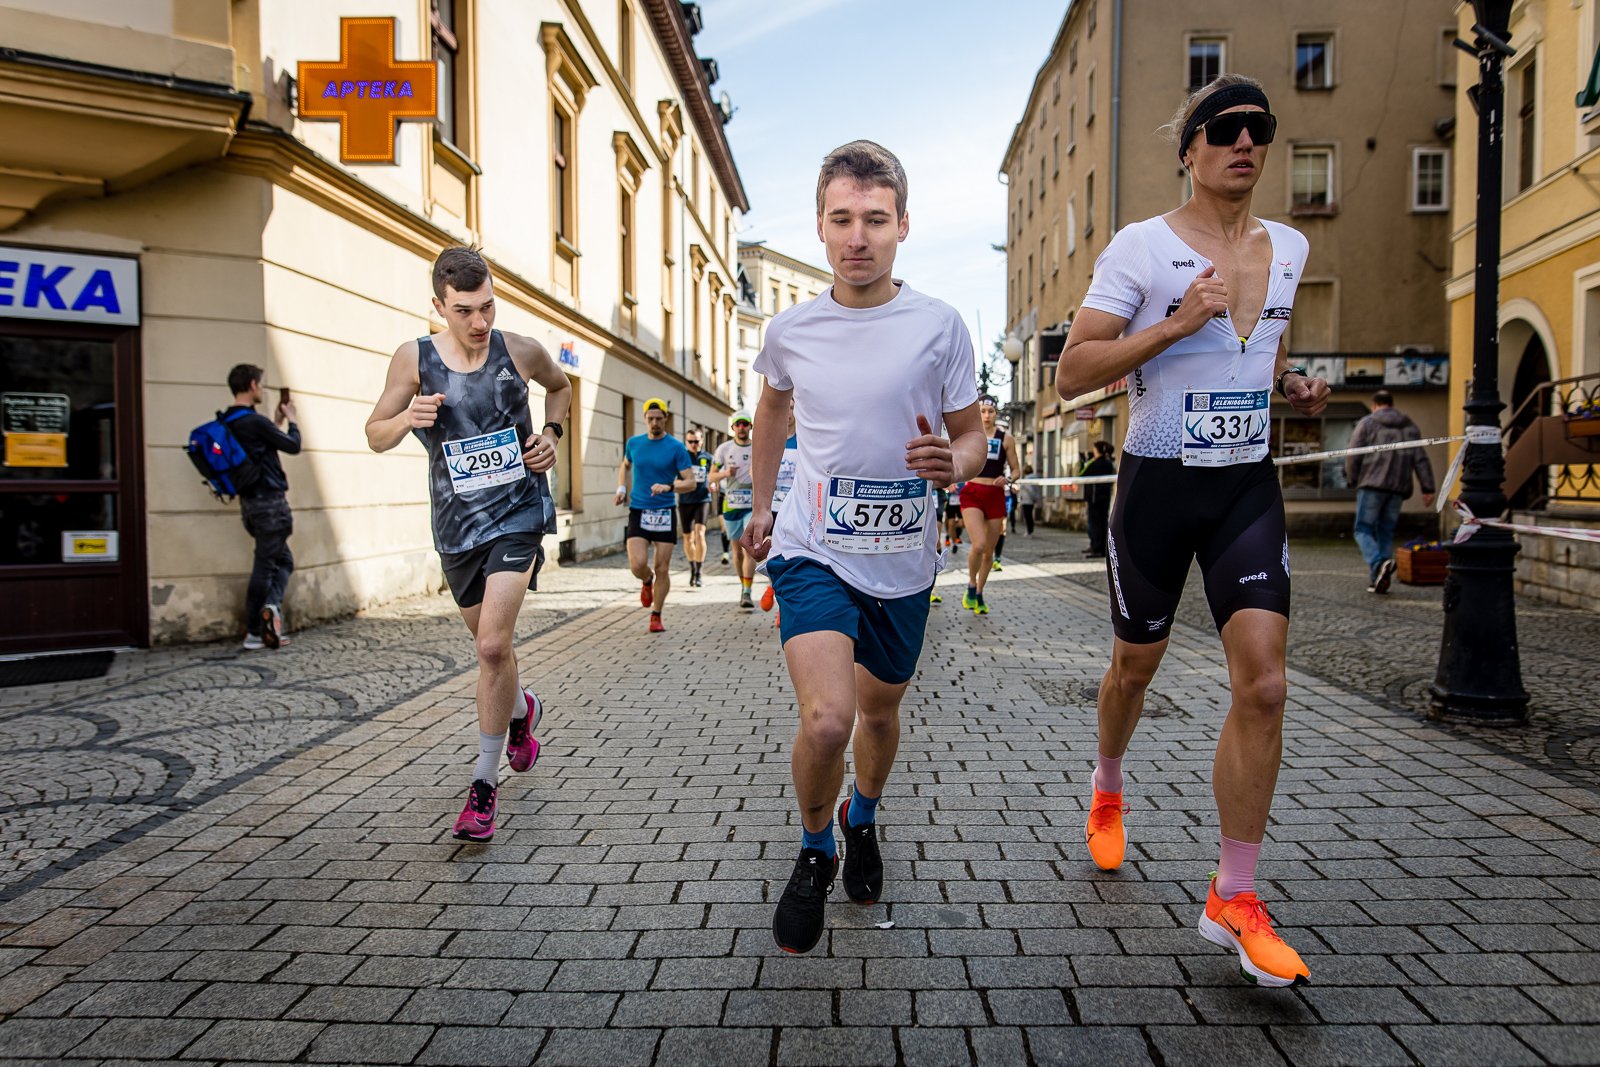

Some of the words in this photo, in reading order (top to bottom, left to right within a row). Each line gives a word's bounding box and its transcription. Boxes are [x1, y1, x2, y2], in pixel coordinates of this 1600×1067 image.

[323, 81, 413, 98] APTEKA
[1172, 259, 1195, 269] quest
[0, 261, 121, 314] EKA
[1210, 414, 1252, 439] 331
[466, 450, 503, 471] 299
[853, 503, 903, 527] 578
[1239, 571, 1268, 584] quest
